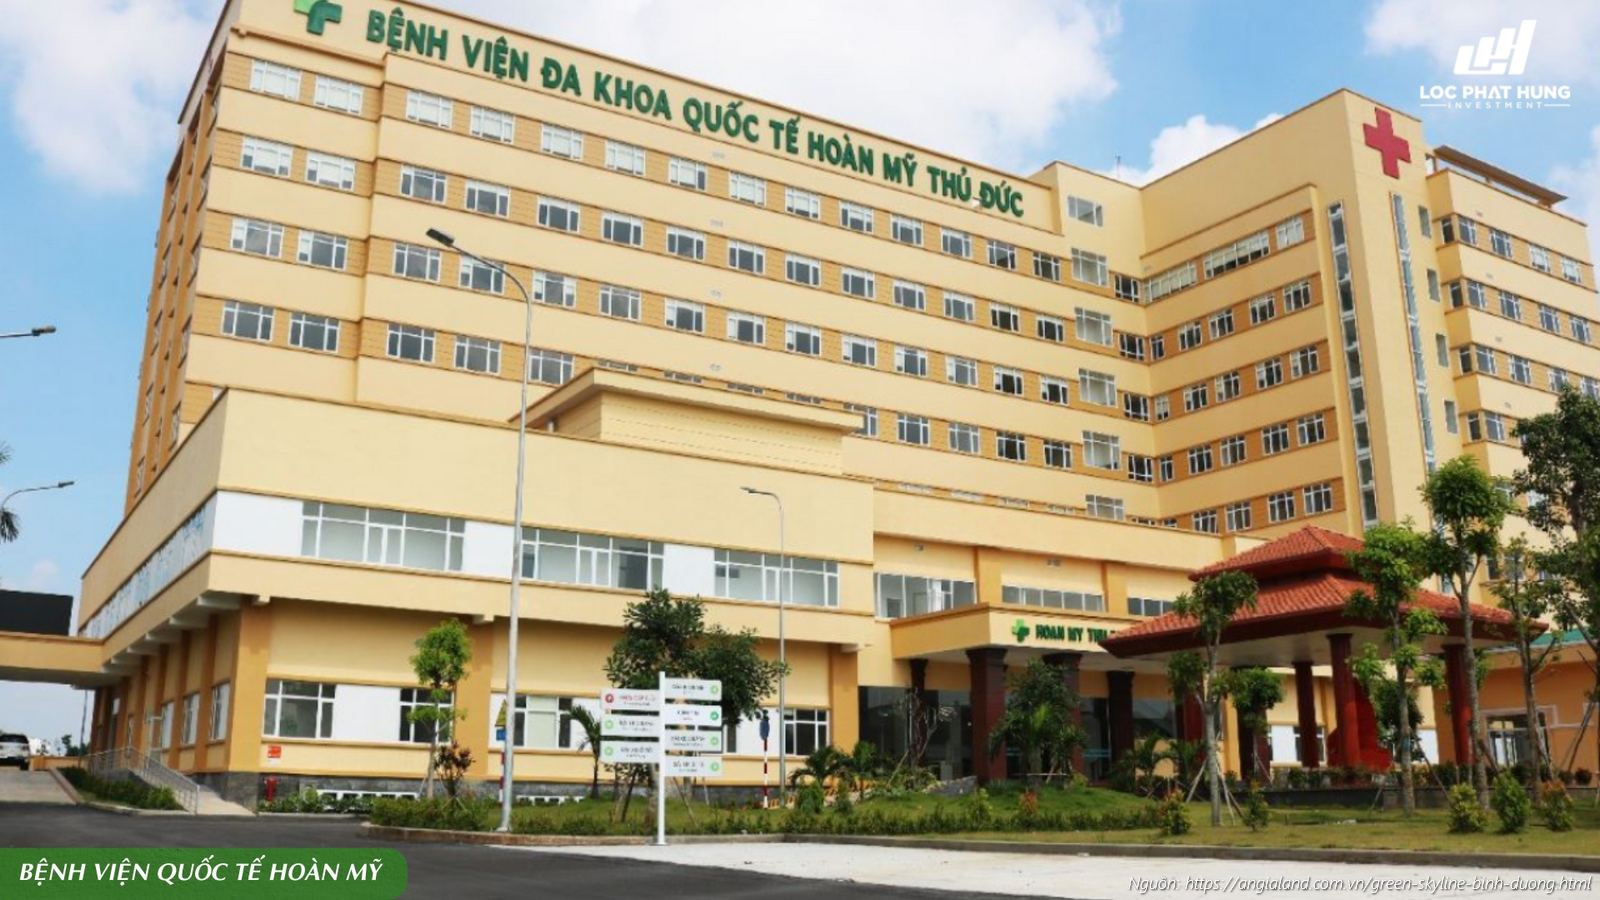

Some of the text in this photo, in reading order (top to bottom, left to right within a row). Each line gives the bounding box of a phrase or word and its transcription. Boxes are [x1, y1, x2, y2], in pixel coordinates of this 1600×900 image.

[366, 6, 1025, 217] BỆNH VIỆN ĐA KHOA QUỐC TẾ HOÀN MỸ THỦ ĐỨC
